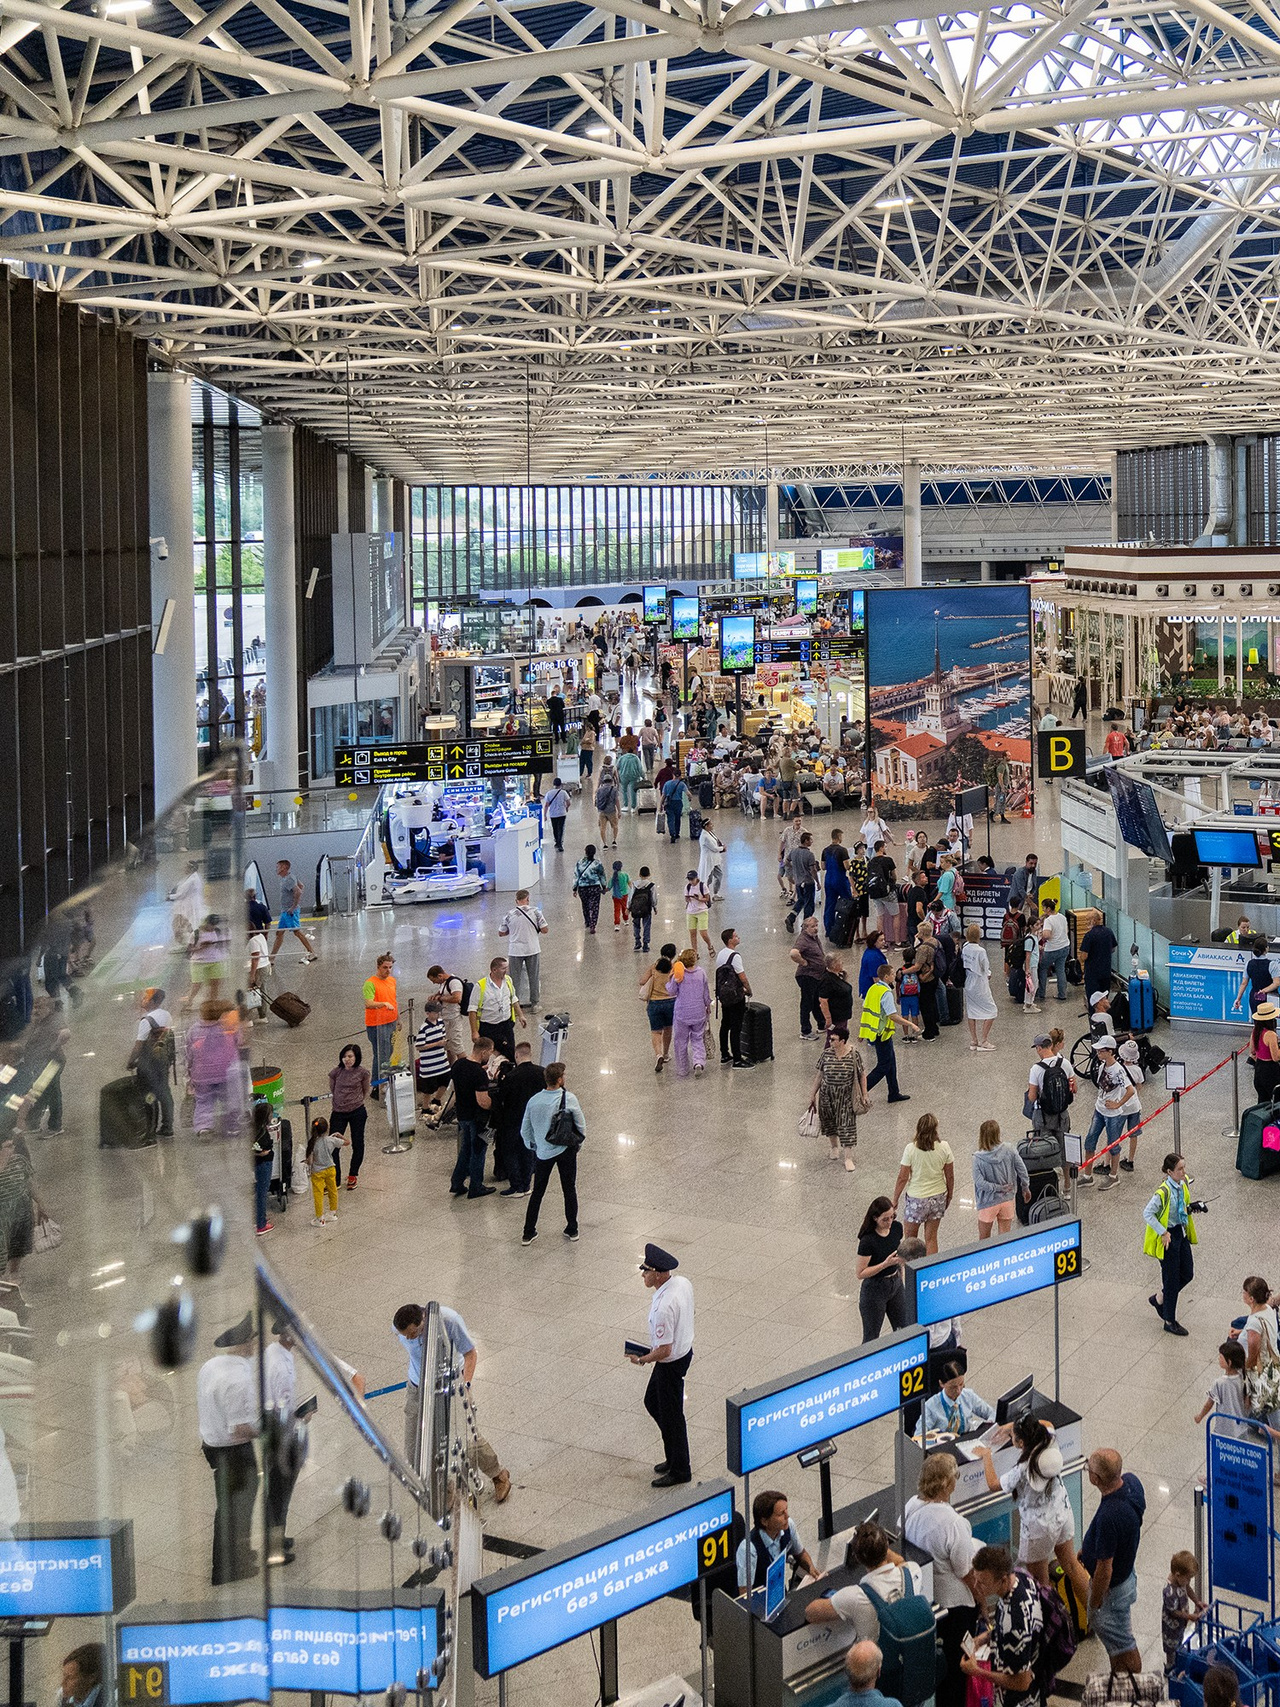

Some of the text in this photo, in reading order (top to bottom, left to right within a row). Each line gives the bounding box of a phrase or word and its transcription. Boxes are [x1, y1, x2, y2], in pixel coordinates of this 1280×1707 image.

[530, 658, 578, 672] Coffee To Go
[920, 1237, 1075, 1292] Регистрация пассажиров
[1057, 1250, 1077, 1276] 93
[965, 1265, 1034, 1293] без багажа
[747, 1352, 925, 1432] Регистрация пассажиров
[902, 1366, 924, 1397] 92
[800, 1388, 878, 1429] без багажа
[1215, 1438, 1262, 1460] Проверьте свою
[1220, 1452, 1258, 1469] ручную кладь
[702, 1529, 729, 1568] 91
[497, 1511, 729, 1624] Регистрация пассажиров
[566, 1561, 669, 1614] без багажа
[796, 1636, 820, 1651] Сочи
